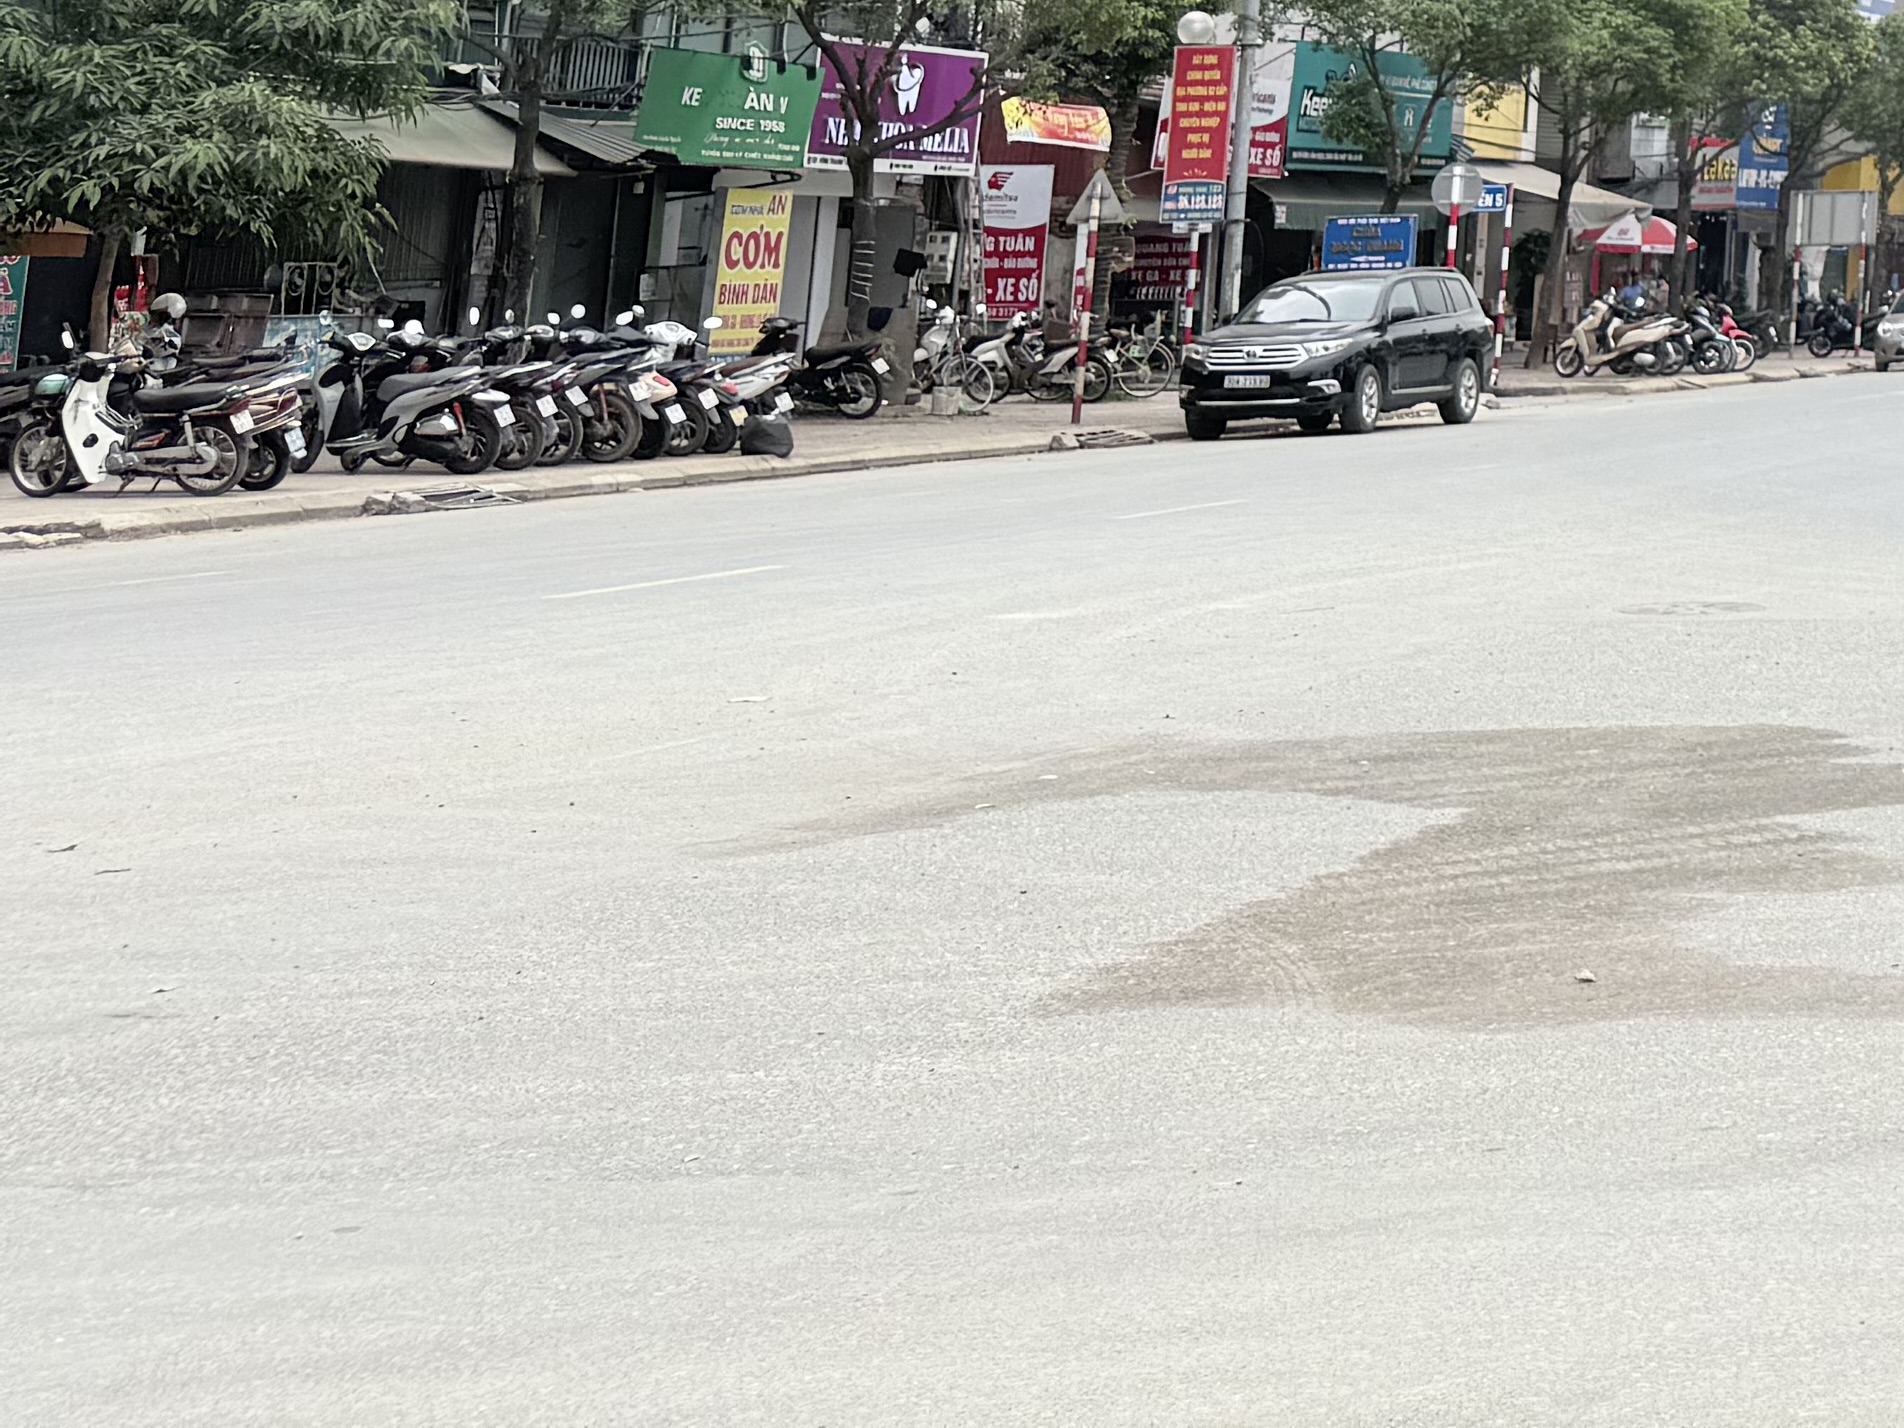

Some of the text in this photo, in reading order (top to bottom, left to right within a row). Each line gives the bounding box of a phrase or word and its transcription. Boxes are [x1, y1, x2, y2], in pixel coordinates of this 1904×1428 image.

[715, 117, 755, 131] SINCE
[724, 224, 784, 270] CƠM
[718, 279, 749, 305] BÌNH
[995, 277, 1015, 302] XE
[1018, 269, 1041, 302] SỐ
